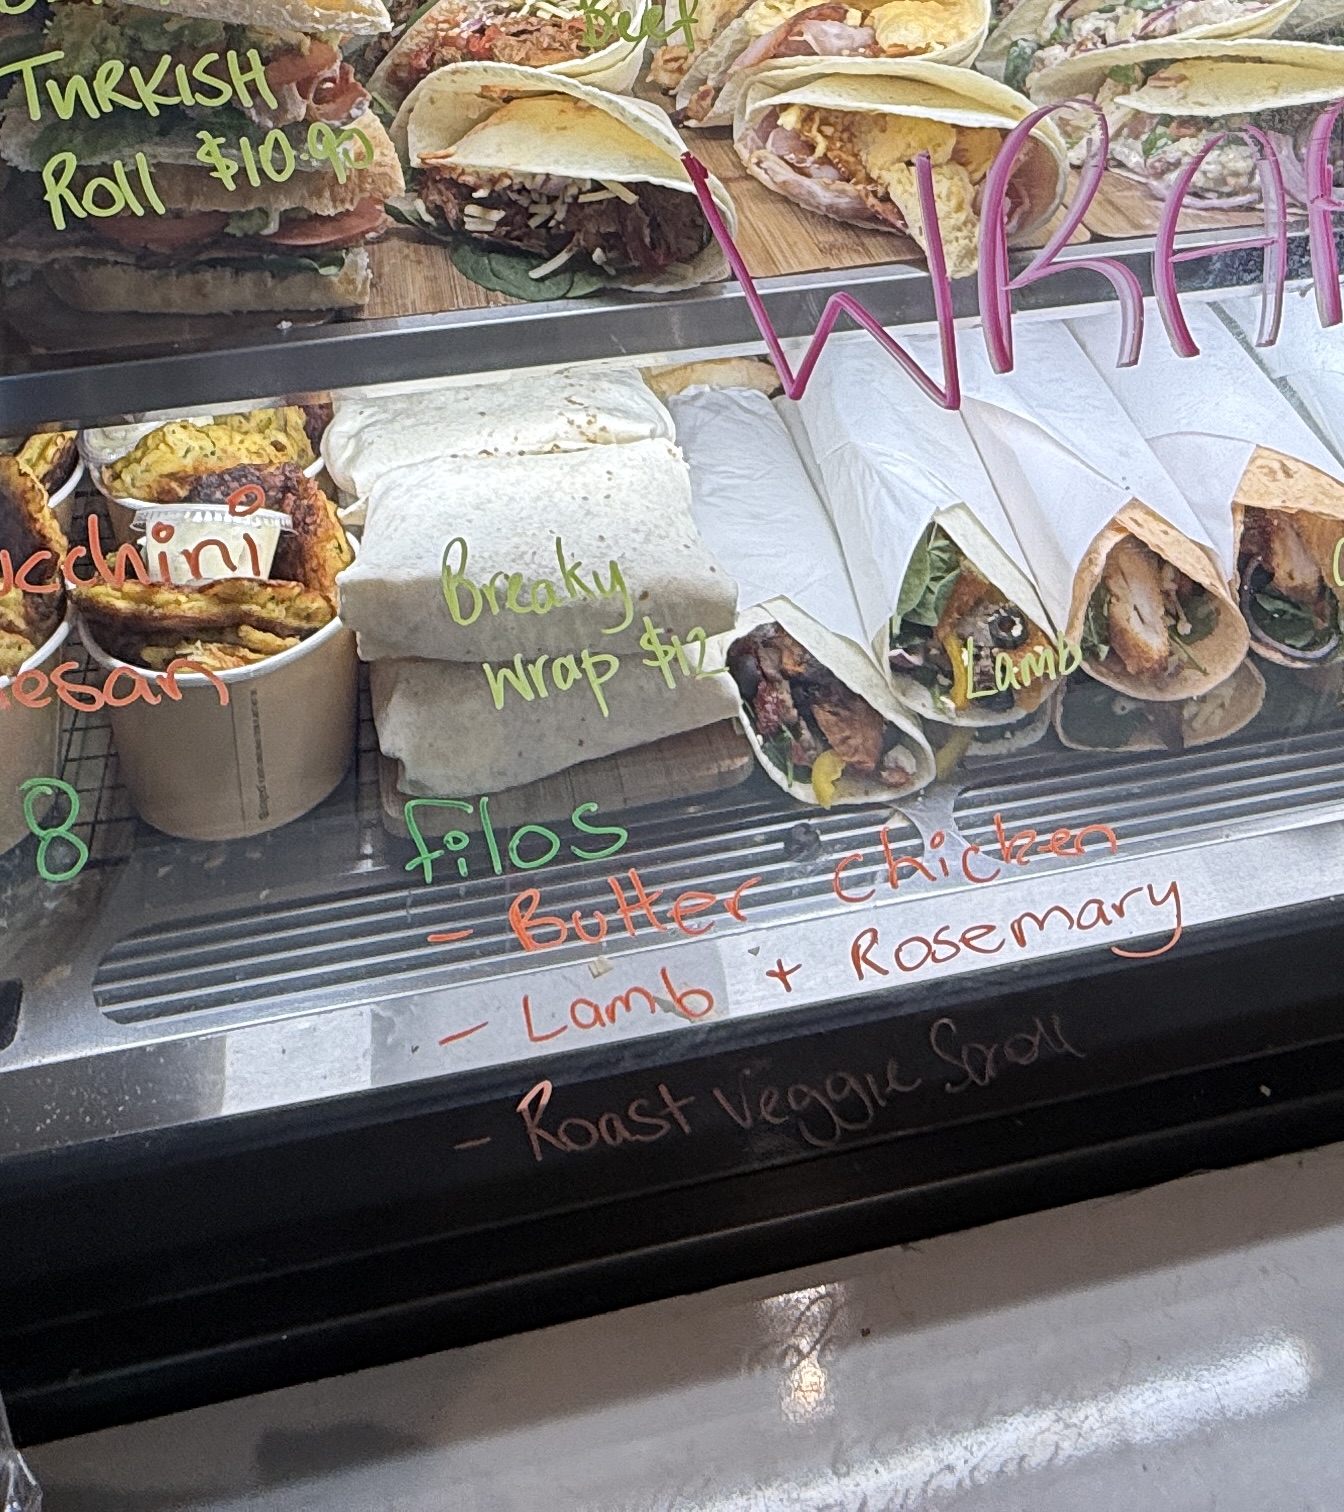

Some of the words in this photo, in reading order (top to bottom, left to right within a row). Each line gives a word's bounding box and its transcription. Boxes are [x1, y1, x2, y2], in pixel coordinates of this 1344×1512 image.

[195, 121, 375, 192] $10.90
[440, 535, 637, 634] Breaky
[959, 636, 1086, 704] Lamb
[520, 968, 716, 1044] Lamb
[849, 879, 1183, 982] Rosemary
[514, 1078, 696, 1162] Roast
